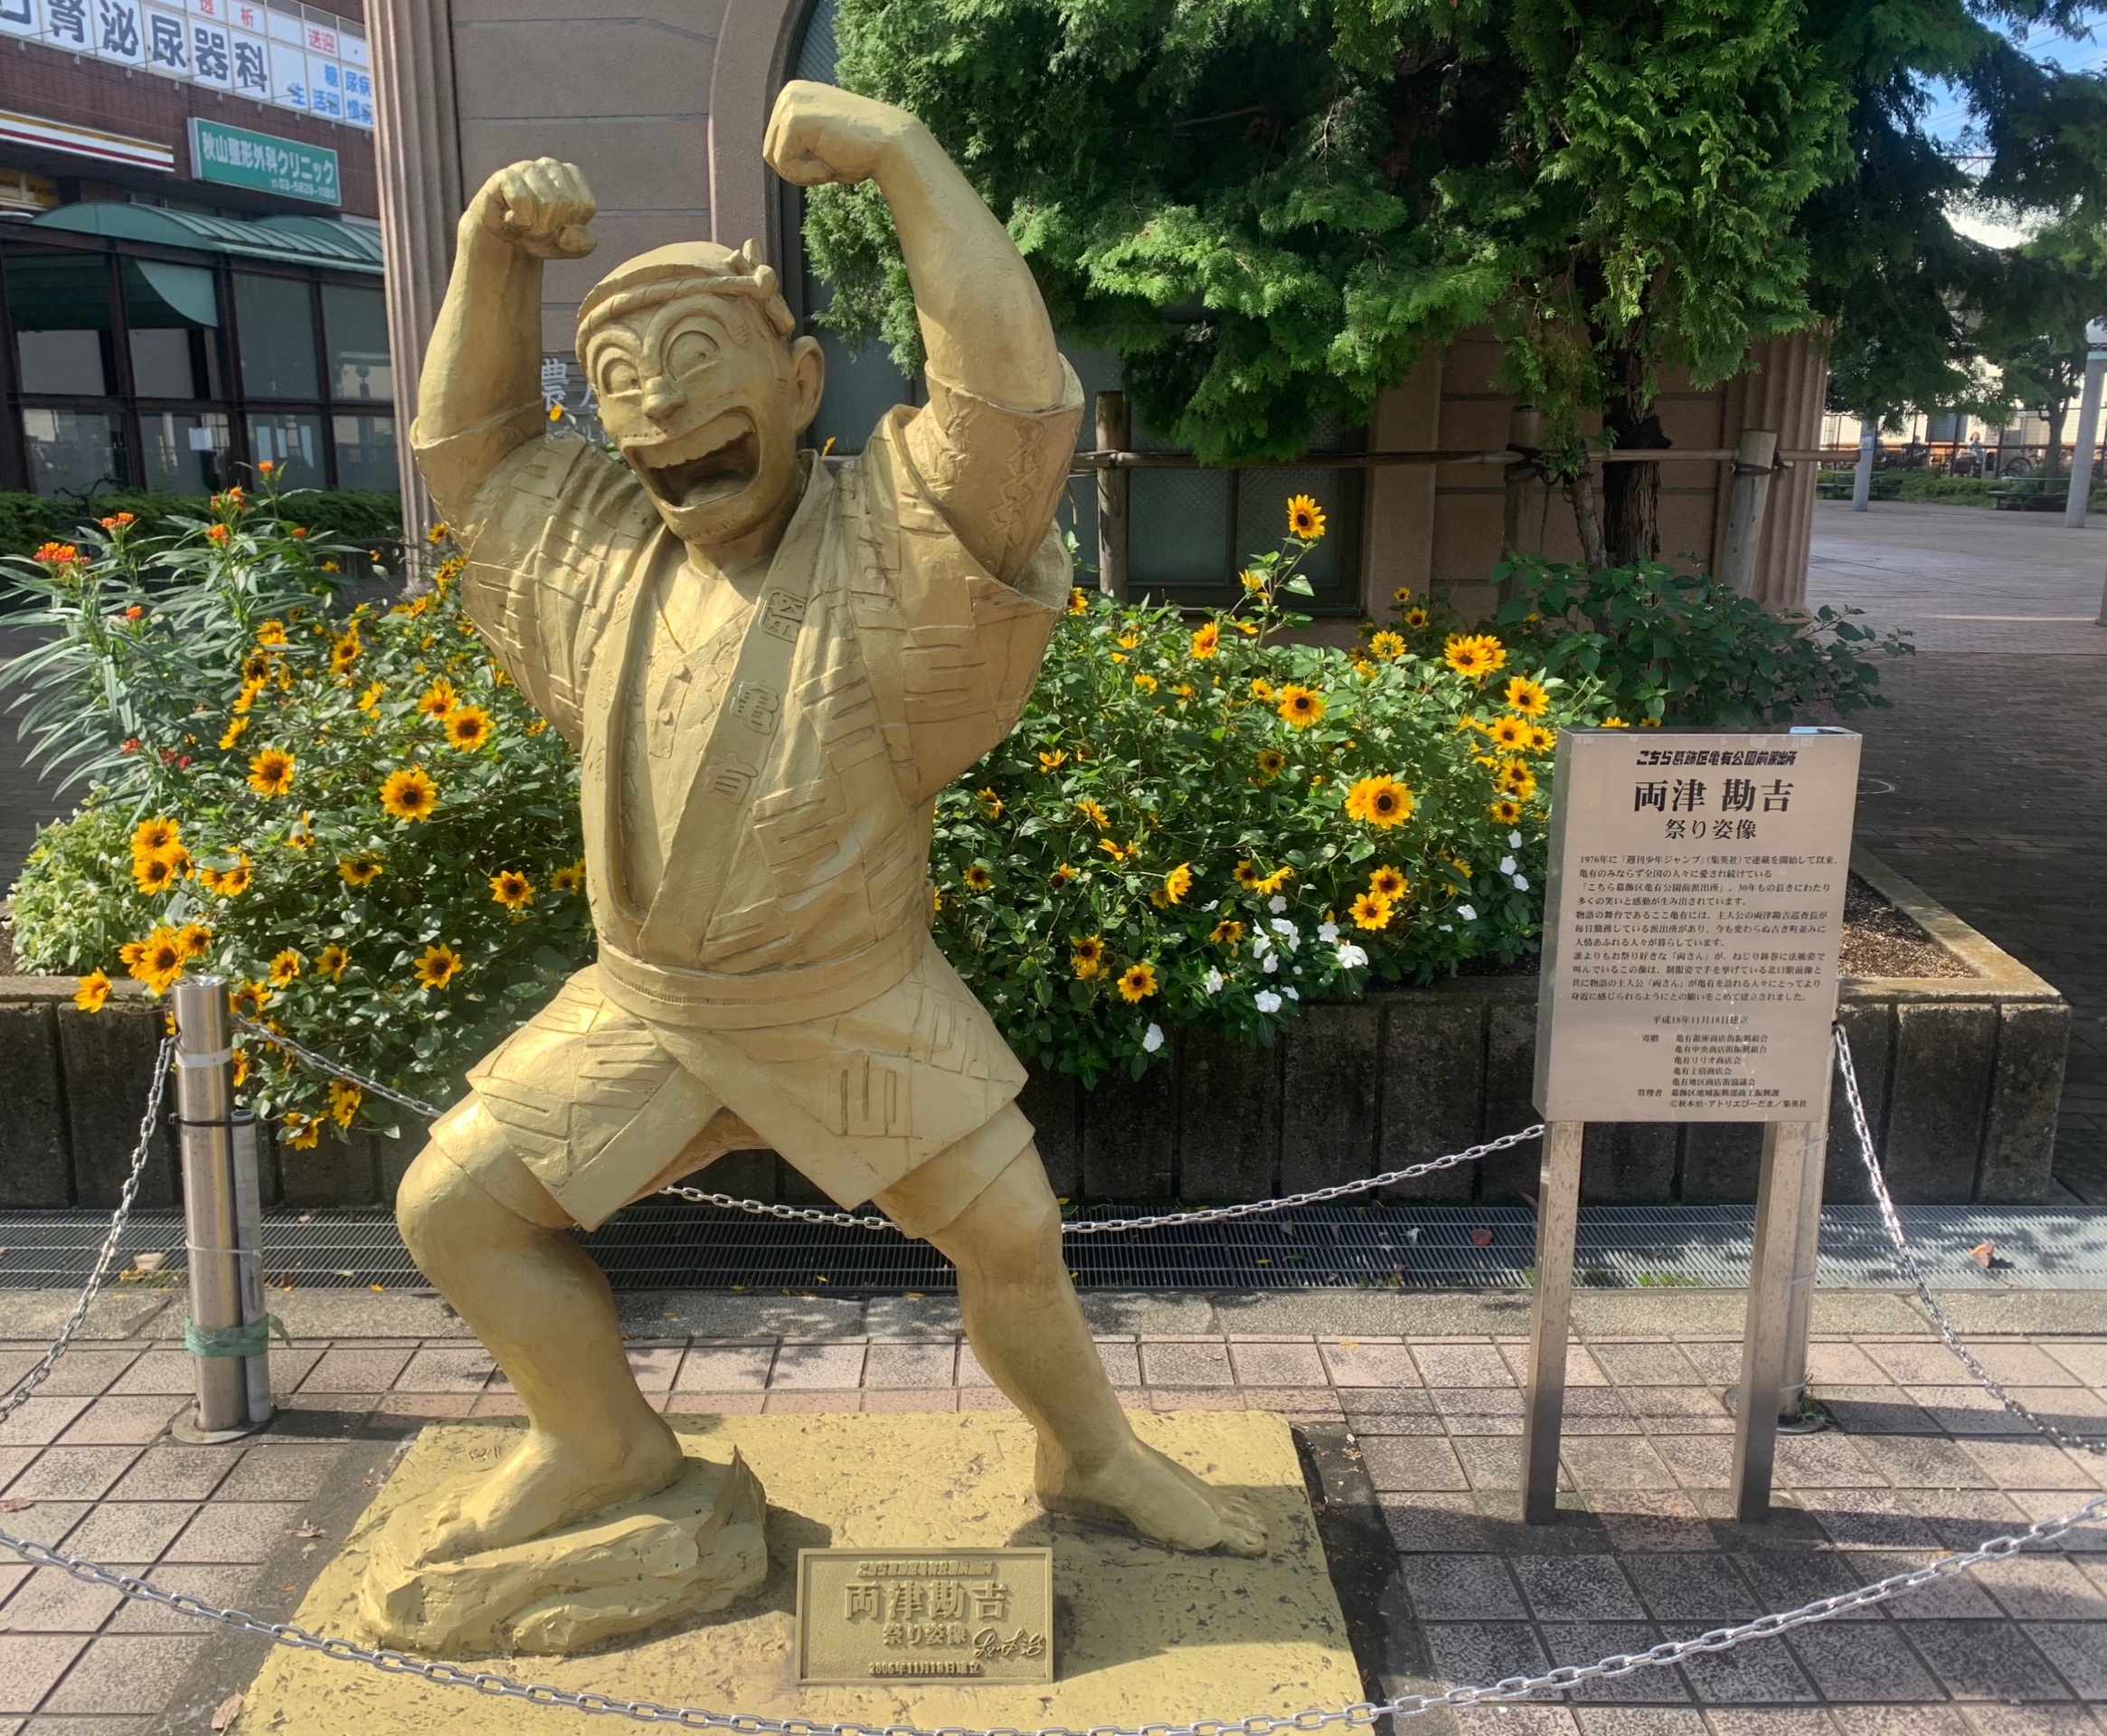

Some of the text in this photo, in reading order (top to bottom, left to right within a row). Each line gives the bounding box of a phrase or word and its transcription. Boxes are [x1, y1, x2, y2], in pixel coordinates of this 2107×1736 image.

[202, 132, 334, 184] 秋山整形外科クリニック
[1636, 750, 1798, 766] こちら葛飾区亀有公園前派出所
[1664, 818, 1757, 841] 祭り姿像
[1579, 868, 1772, 879] 亀有のみならず全国の人々に愛され続けている
[1577, 896, 1746, 906] 多くの笑いと感動が生み出されています。
[1574, 938, 1724, 948] 人情あふれる人々が暮らしています。
[1653, 1015, 1749, 1024] 平成18年11月18日建立
[1674, 1056, 1741, 1064] 亀有リリオ商店会
[1638, 1089, 1663, 1097] 管理者
[845, 1580, 1007, 1620] 両津勘吉
[883, 1623, 968, 1646] 祭り姿像
[868, 1661, 981, 1675] 2006年11月18日建立
